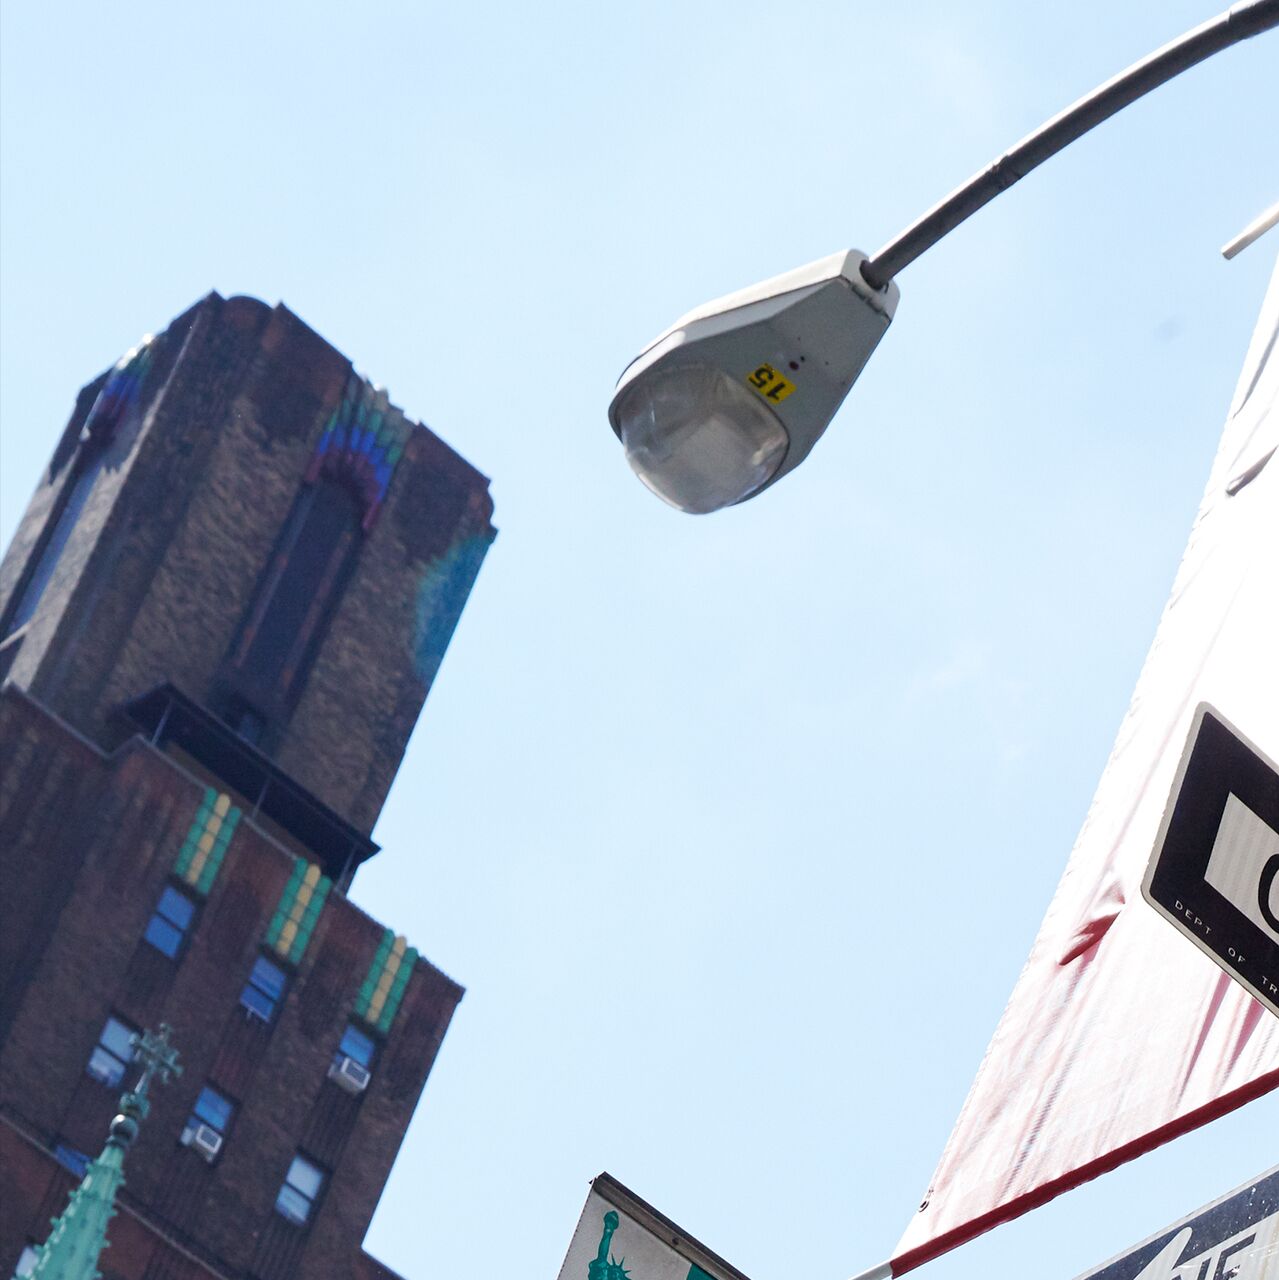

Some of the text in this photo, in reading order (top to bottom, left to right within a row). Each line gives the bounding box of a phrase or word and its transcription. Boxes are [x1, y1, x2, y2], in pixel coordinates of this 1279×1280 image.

[748, 367, 786, 400] 15
[1174, 899, 1212, 935] DEPT
[1227, 947, 1246, 963] OF
